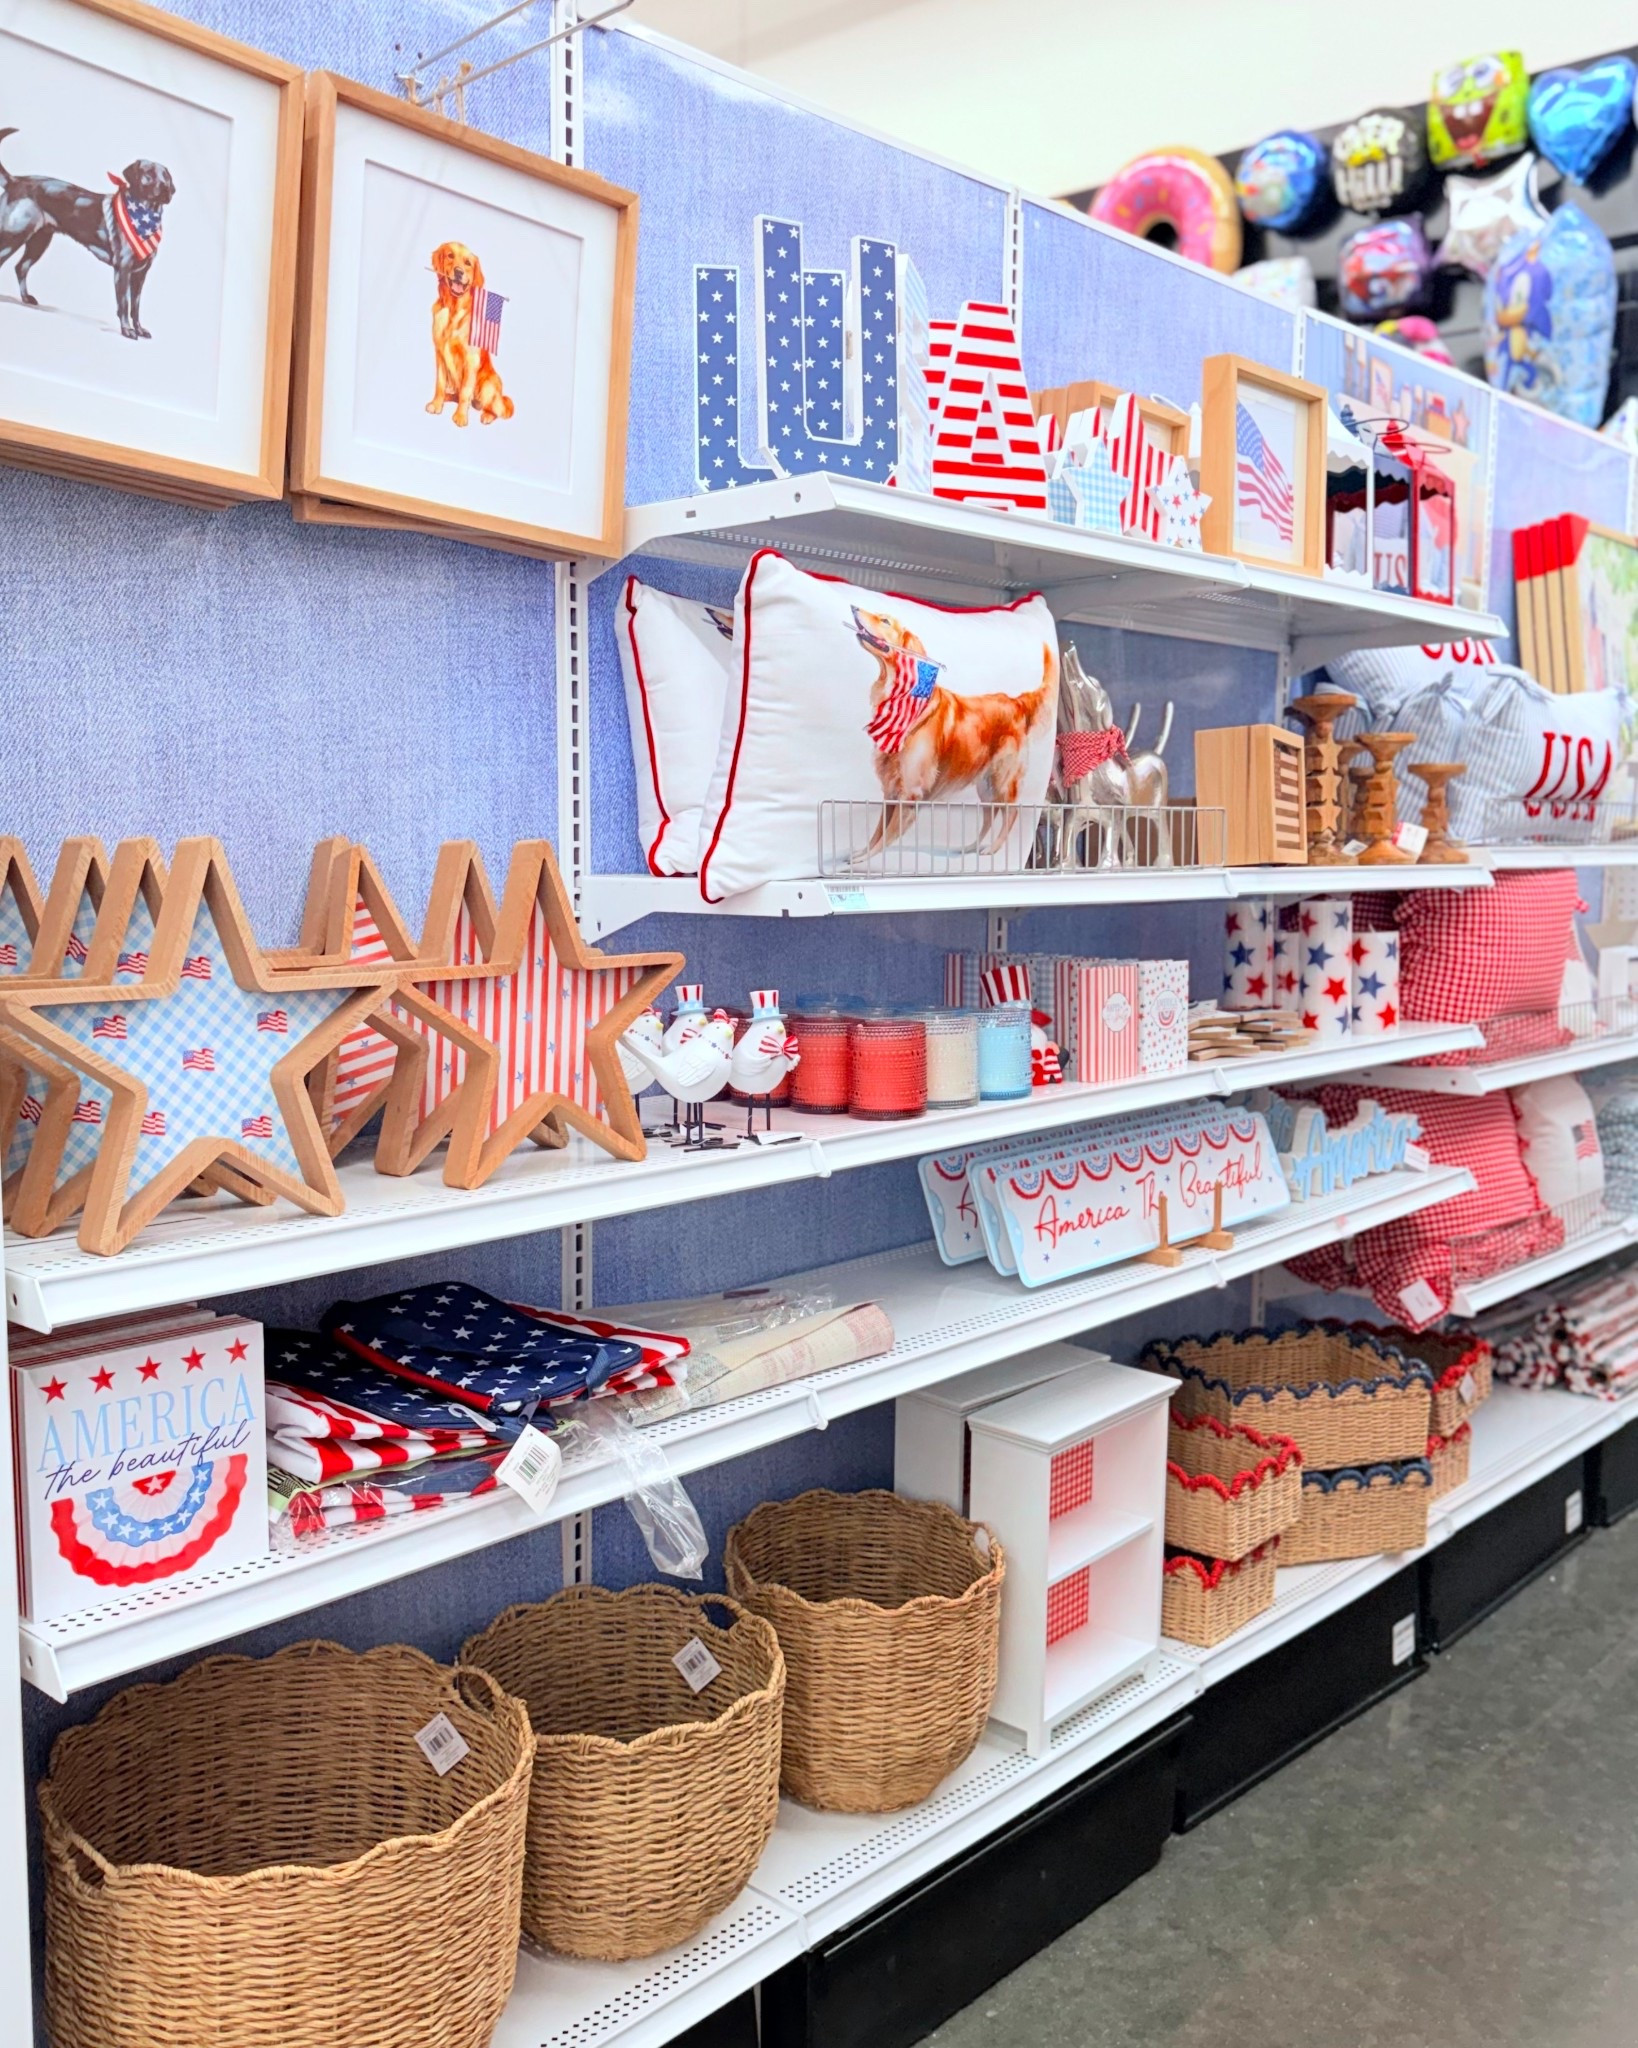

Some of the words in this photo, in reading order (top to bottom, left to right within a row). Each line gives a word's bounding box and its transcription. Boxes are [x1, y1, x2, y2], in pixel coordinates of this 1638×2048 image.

[1034, 1194, 1130, 1250] America
[1179, 1141, 1263, 1208] Beatiful
[37, 1373, 257, 1472] AMERICA
[44, 1460, 102, 1499] the
[108, 1418, 252, 1480] beautiful
